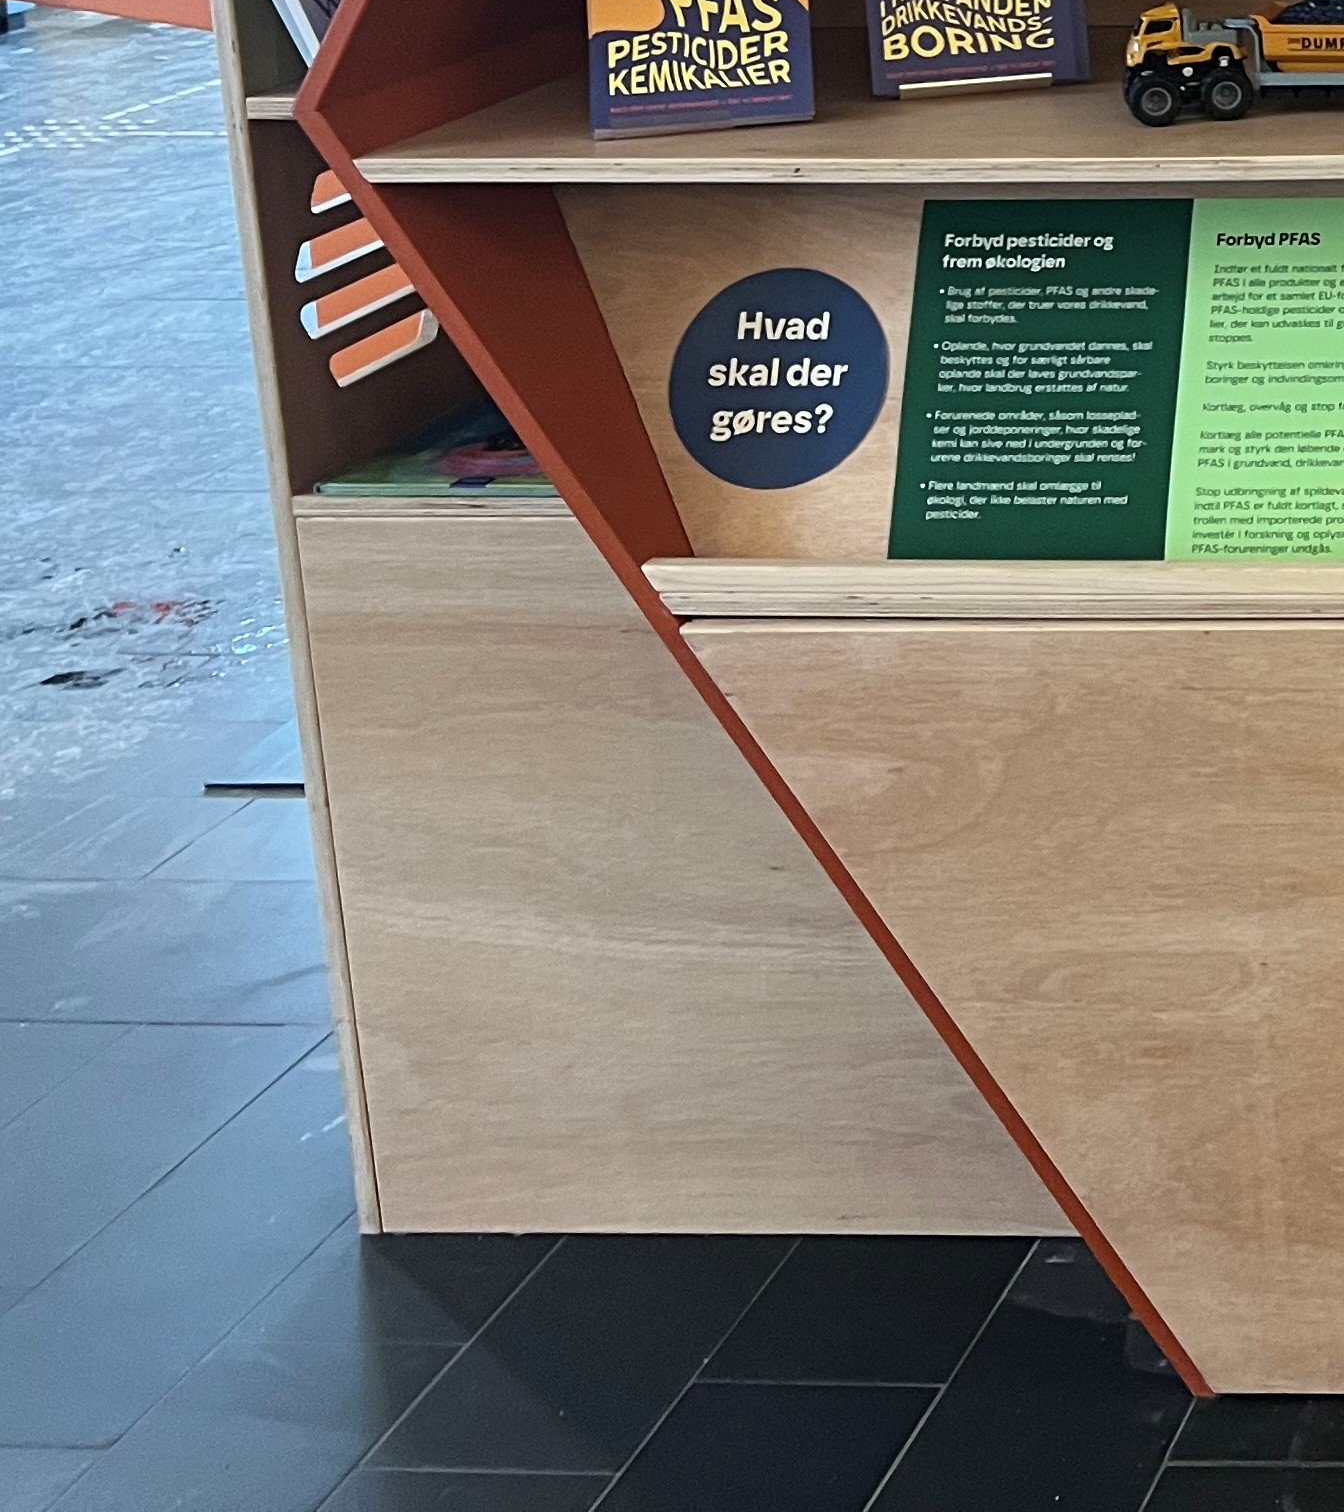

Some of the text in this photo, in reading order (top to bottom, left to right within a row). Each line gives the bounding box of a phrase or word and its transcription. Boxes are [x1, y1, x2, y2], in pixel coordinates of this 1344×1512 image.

[607, 30, 790, 75] PESTICIDER
[882, 25, 1055, 62] BORING
[608, 52, 791, 96] KEMIKALIER
[944, 232, 1114, 252] Forbyd pesticider og
[1216, 232, 1321, 250] Forbyd PFAS
[942, 253, 1066, 273] frem økologien
[737, 311, 831, 341] Hvad
[707, 357, 849, 387] skal der
[709, 403, 834, 442] gøres?
